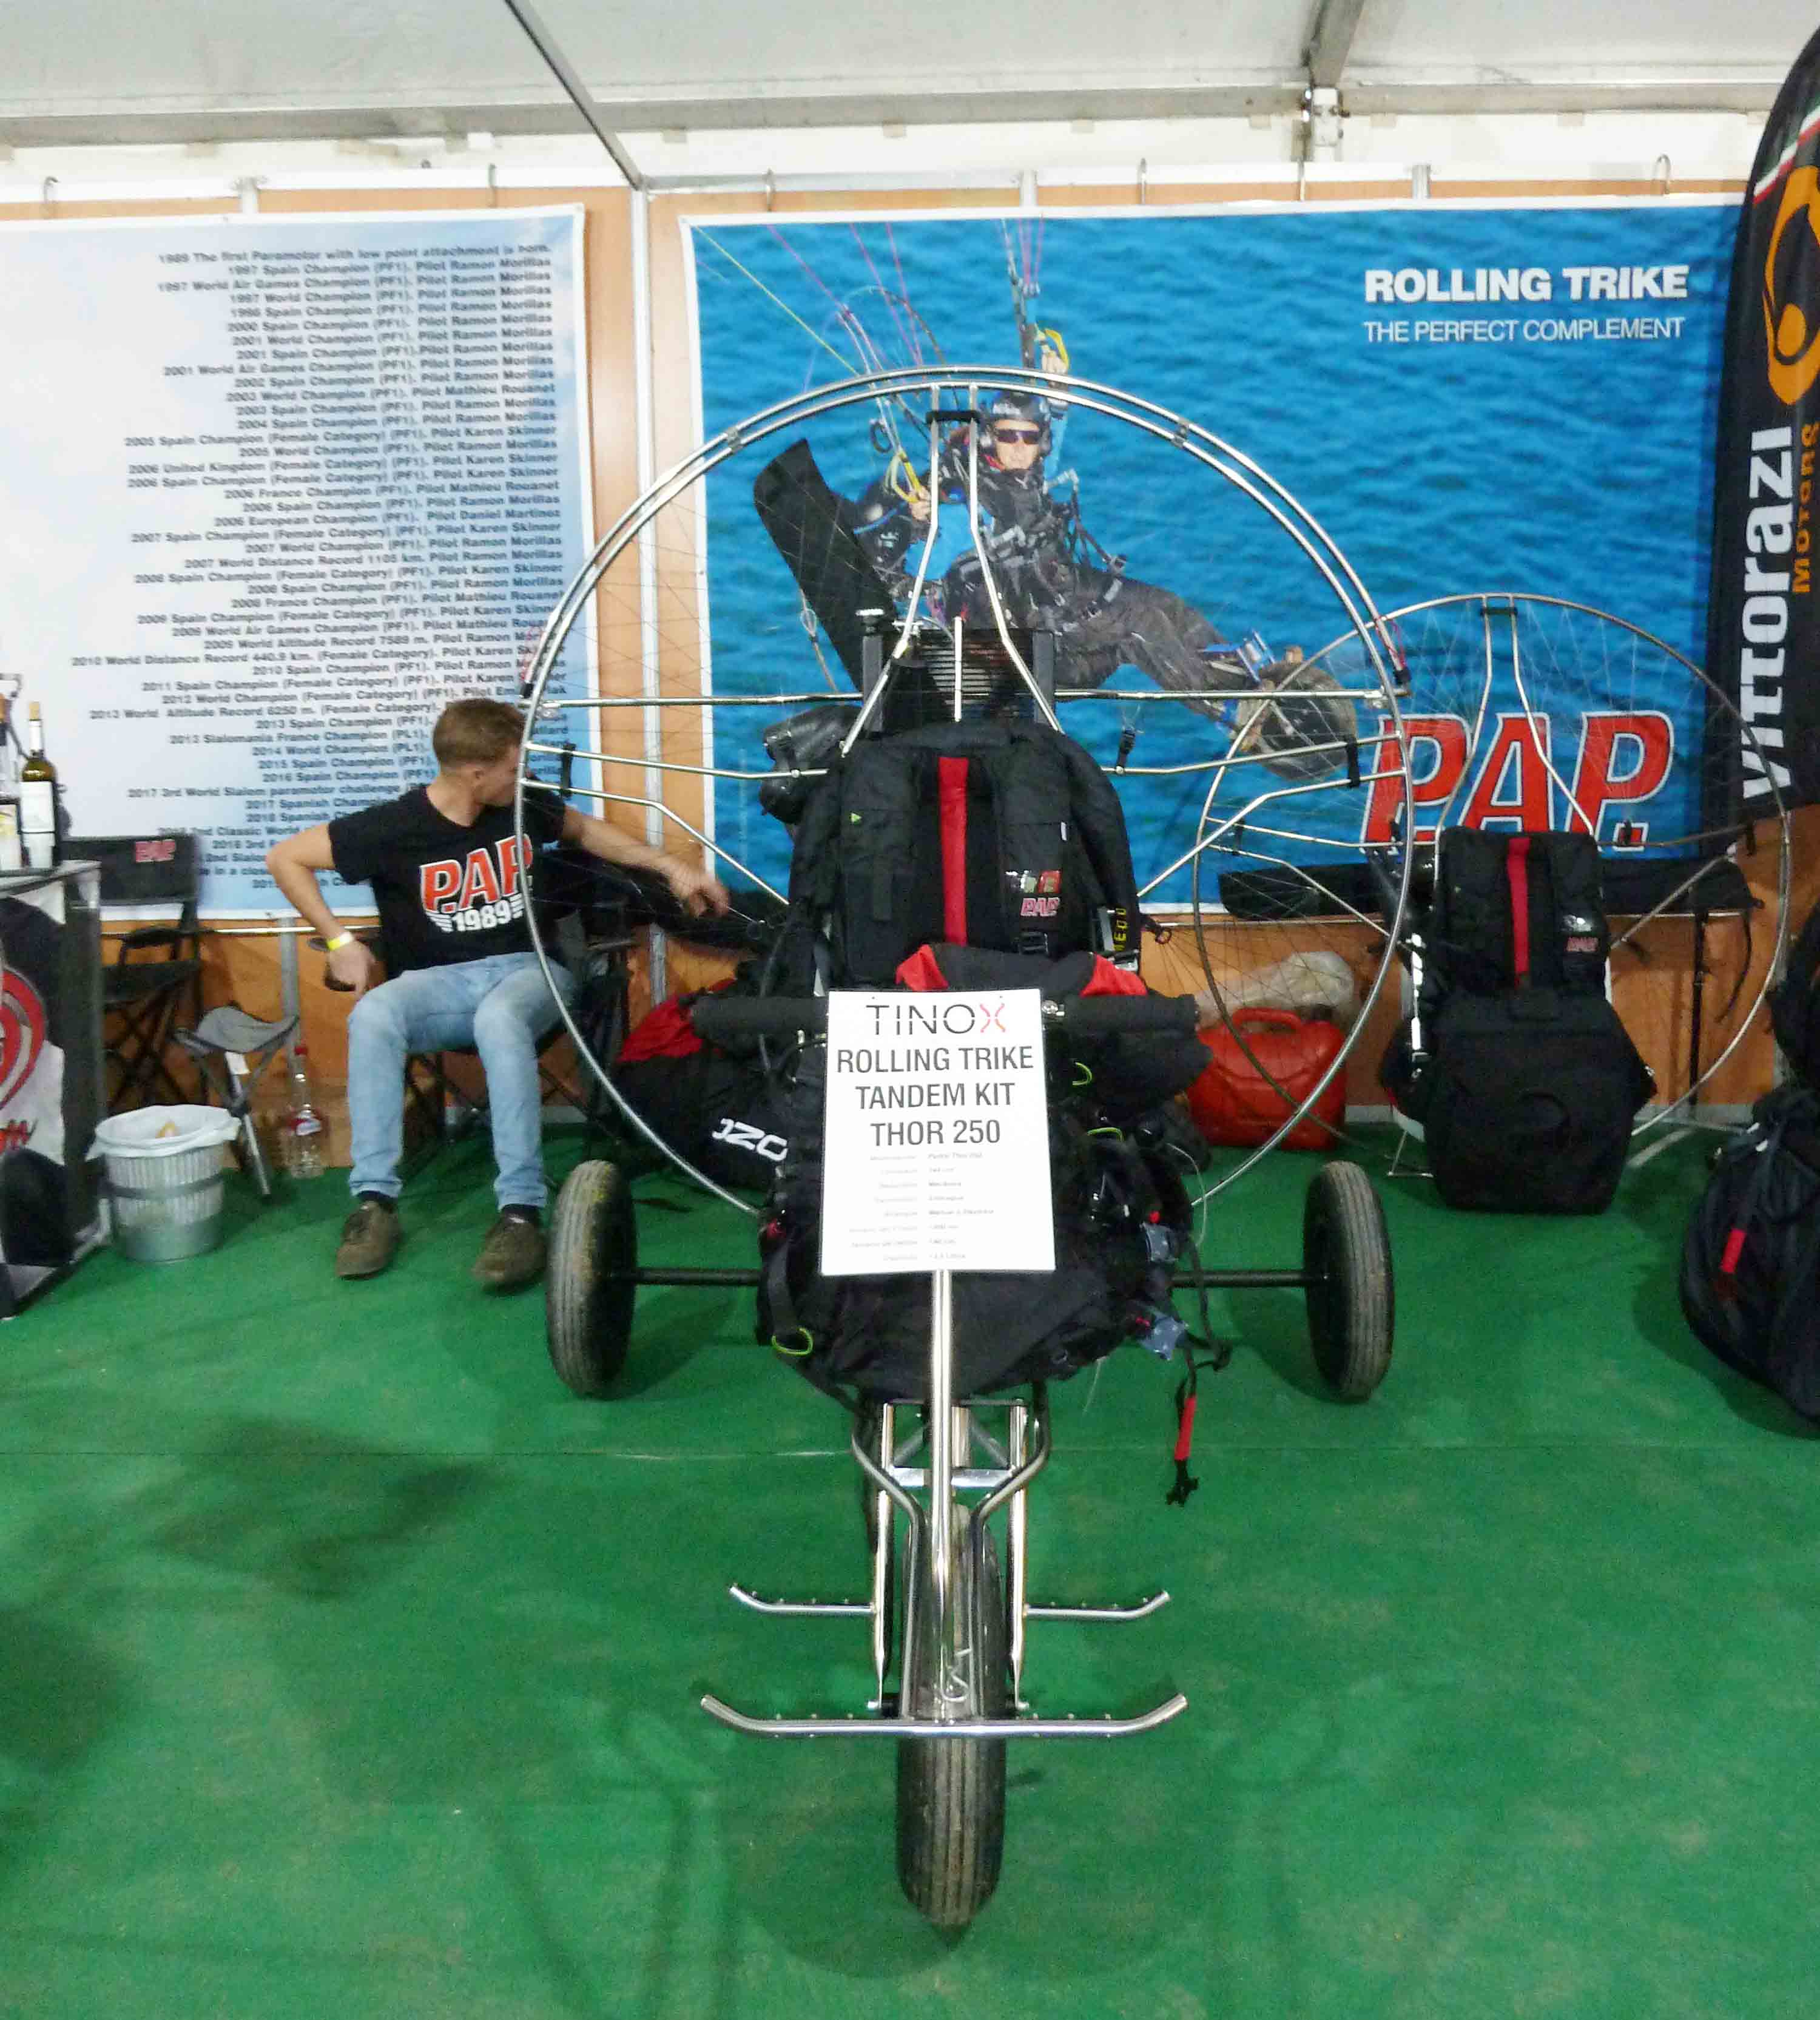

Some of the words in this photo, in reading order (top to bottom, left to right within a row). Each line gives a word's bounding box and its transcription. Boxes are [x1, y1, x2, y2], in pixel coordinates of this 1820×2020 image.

[1365, 268, 1551, 303] ROLLING
[1562, 265, 1689, 300] TRIKE
[1364, 321, 1409, 342] THE
[1415, 320, 1518, 342] PERFECT
[1523, 317, 1685, 340] COMPLEMENT
[261, 392, 297, 401] World
[301, 391, 366, 403] Champion
[412, 387, 440, 396] Pilot
[259, 490, 302, 498] France
[306, 487, 371, 500] Champion
[416, 484, 445, 493] Pilot
[249, 517, 309, 529] European
[313, 515, 377, 527] Champion
[426, 511, 456, 520] Pilot
[166, 533, 201, 546] Spain
[206, 532, 269, 544] Champion
[436, 524, 465, 534] Pilot
[470, 524, 508, 533] Karen
[512, 522, 561, 532] Skinner
[280, 543, 314, 552] World
[319, 542, 383, 554] Champion
[428, 538, 458, 548] Pilot
[462, 538, 506, 547] Ramon
[511, 536, 561, 546] Morillas
[219, 559, 254, 567] World
[258, 558, 314, 567] Distance
[318, 556, 363, 565] Record
[429, 552, 458, 562] Pilot
[462, 552, 507, 561] Ramon
[511, 550, 562, 559] Morillas
[266, 599, 308, 607] France
[312, 597, 377, 609] Champion
[422, 593, 451, 603] Pilot
[206, 627, 241, 636] World
[246, 626, 261, 635] Air
[267, 626, 310, 635] Games
[314, 624, 378, 636] Champion
[423, 620, 452, 630] Pilot
[238, 640, 273, 649] World
[278, 639, 326, 647] Altitude
[331, 638, 375, 646] Record
[433, 634, 462, 643] Pilot
[467, 633, 508, 642] Ramon
[106, 657, 141, 666] World
[145, 656, 200, 665] Distance
[204, 655, 248, 663] Record
[442, 647, 471, 657] Pilot
[475, 647, 513, 656] Karen
[196, 695, 231, 703] World
[235, 694, 297, 706] Champion
[463, 687, 491, 697] Pilot
[124, 710, 158, 720] World
[167, 709, 214, 718] Altitude
[219, 708, 263, 717] Record
[324, 731, 387, 744] Champion
[286, 746, 321, 755] World
[325, 745, 388, 757] Champion
[292, 760, 326, 771] Spain
[331, 758, 394, 770] Champion
[296, 773, 331, 785] Spain
[336, 772, 398, 783] Champion
[186, 788, 220, 798] World
[452, 900, 511, 931] 1989
[866, 1003, 1006, 1035] TINOX
[838, 1047, 949, 1073] ROLLING
[958, 1045, 1034, 1070] TRIKE
[855, 1083, 966, 1109] TANDEM
[976, 1083, 1015, 1106] KIT
[870, 1120, 944, 1146] THOR
[953, 1119, 1000, 1144] 250
